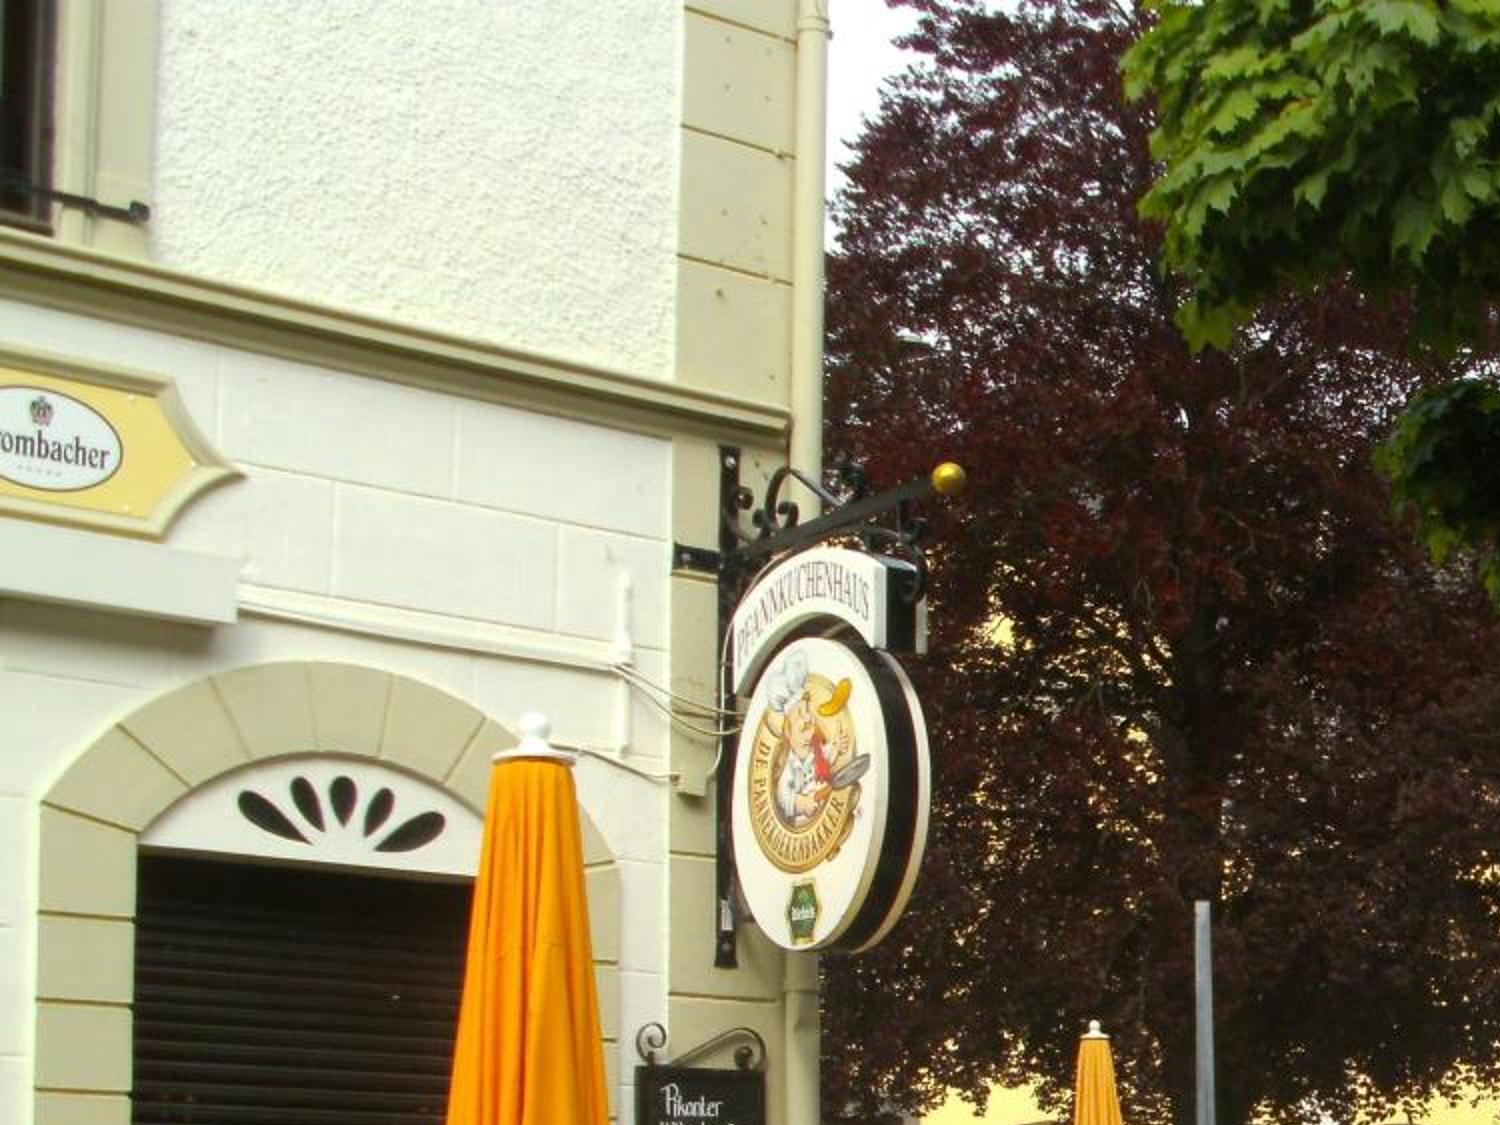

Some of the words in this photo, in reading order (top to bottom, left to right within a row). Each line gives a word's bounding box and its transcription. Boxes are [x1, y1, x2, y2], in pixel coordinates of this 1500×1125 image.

[0, 429, 111, 471] ombacher
[737, 560, 869, 667] PFANNKUCHENHAUS
[660, 1083, 724, 1117] Pikanter
